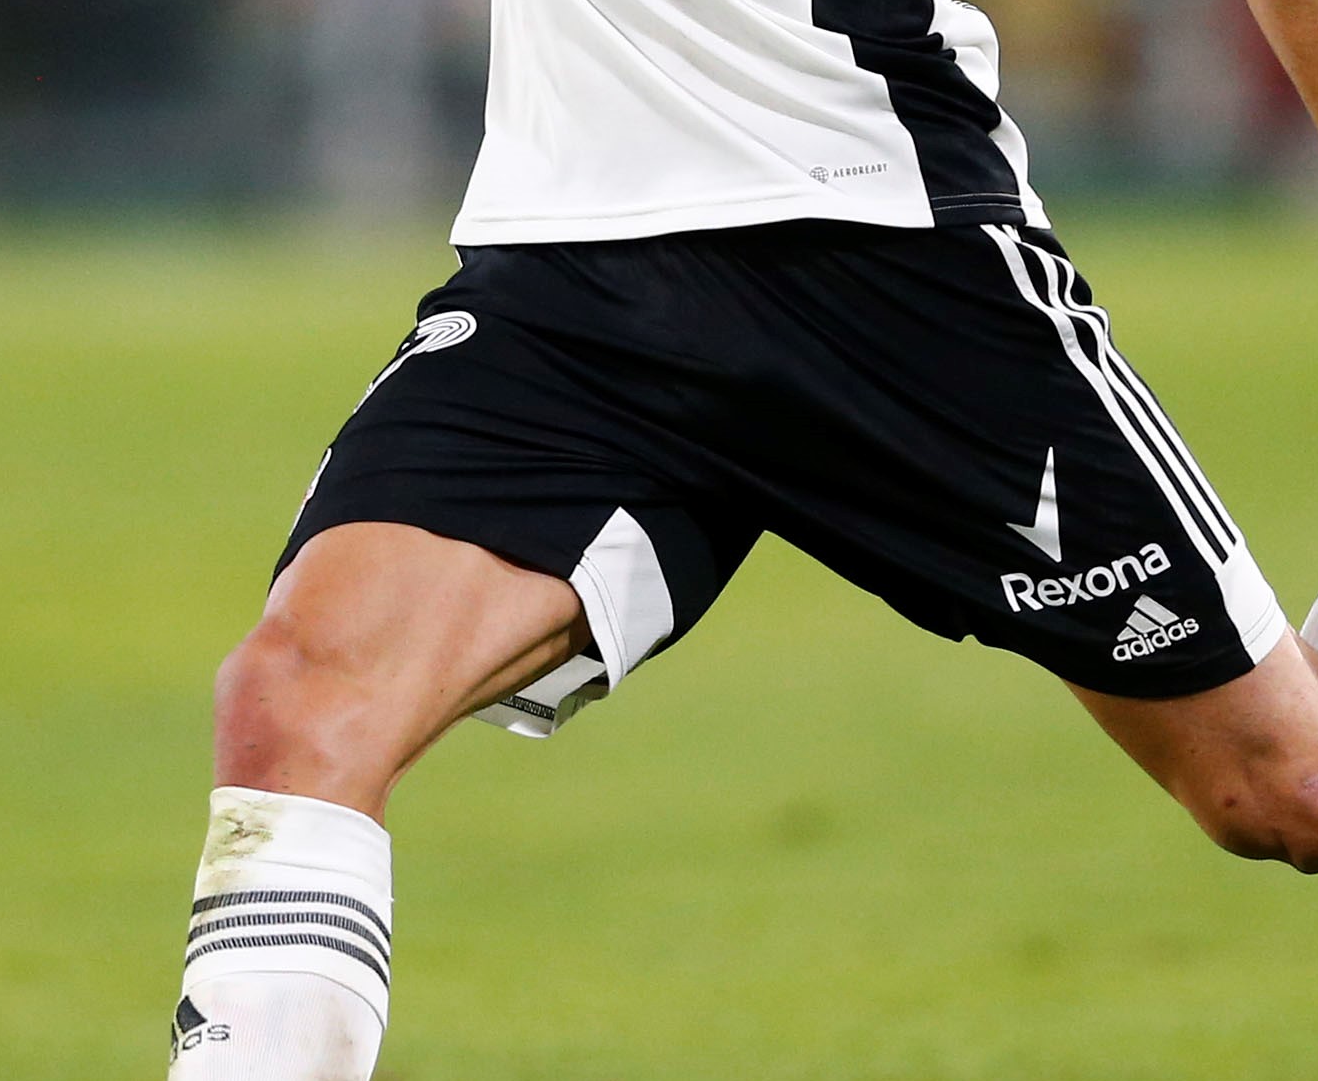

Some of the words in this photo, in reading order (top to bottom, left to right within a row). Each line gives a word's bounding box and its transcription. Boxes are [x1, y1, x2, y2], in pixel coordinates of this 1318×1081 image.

[833, 163, 888, 178] AEROREADY
[1000, 543, 1172, 613] Rexona
[1112, 617, 1200, 661] adidas
